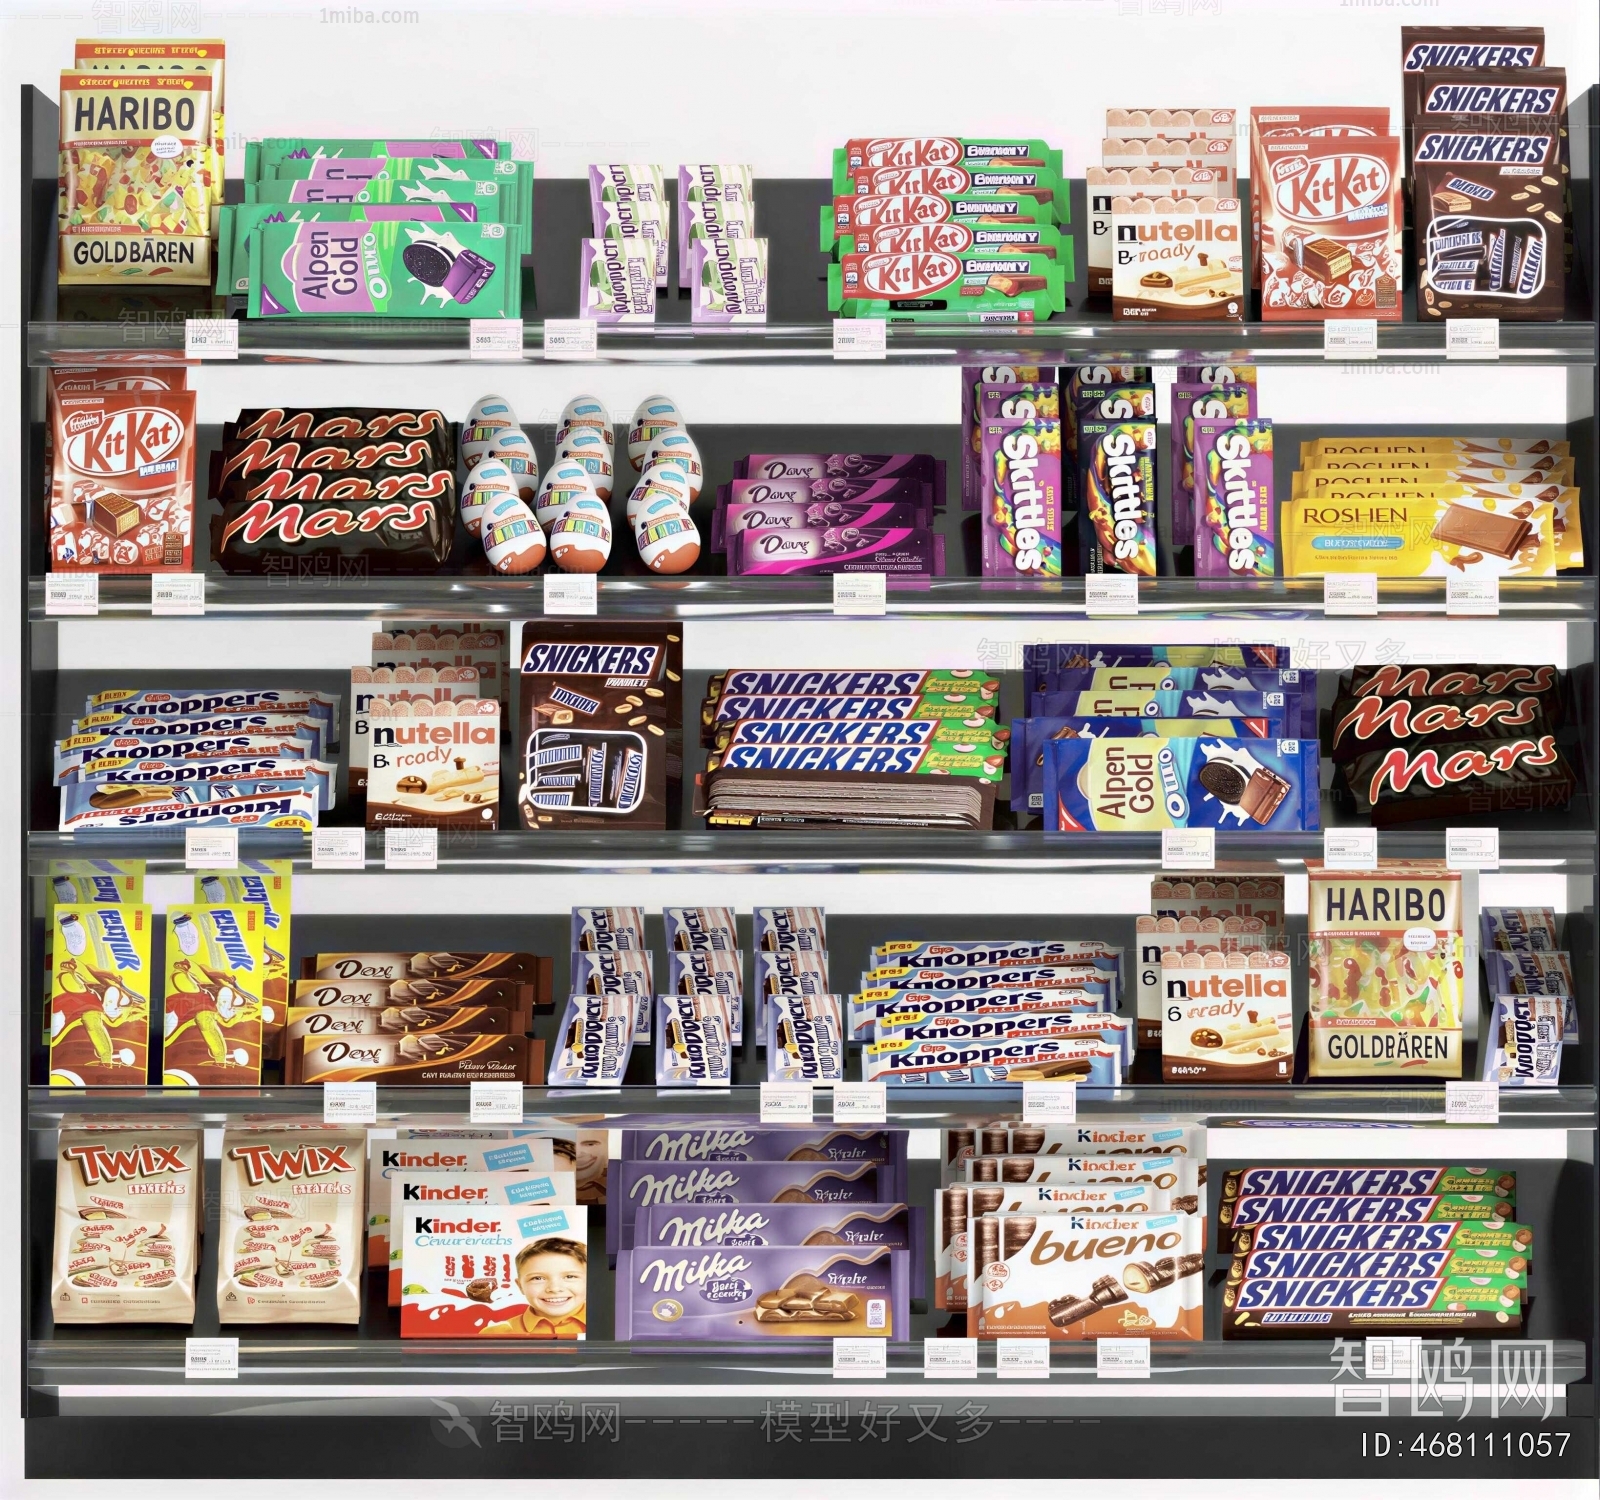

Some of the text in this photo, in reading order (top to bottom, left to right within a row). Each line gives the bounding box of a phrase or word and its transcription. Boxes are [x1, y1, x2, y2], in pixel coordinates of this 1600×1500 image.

[1406, 44, 1535, 67] SNICKERS
[74, 96, 195, 132] HARIBO
[1427, 86, 1557, 114] SNICKERS
[1419, 135, 1548, 163] SNICKERS
[1291, 157, 1381, 217] KitKat
[1117, 219, 1238, 242] nutella
[301, 231, 329, 300] Alpen
[330, 237, 359, 296] Gold
[236, 408, 444, 439] Mars
[83, 412, 173, 472] KitKat
[219, 438, 432, 484] Mars
[245, 468, 454, 501] Mars
[221, 500, 435, 551] Mars
[1303, 507, 1407, 524] ROSHEN
[524, 644, 655, 675] SNICKERS
[726, 672, 920, 694] SNICKERS
[1353, 665, 1555, 696] Mars
[718, 697, 913, 719] SNICKERS
[1333, 695, 1539, 749] Mars
[374, 722, 496, 745] nutella
[735, 721, 931, 744] SNICKERS
[725, 746, 921, 773] SNICKERS
[1369, 735, 1558, 805] Mars
[1097, 747, 1125, 820] Alpen
[1127, 754, 1155, 814] Gold
[1326, 887, 1446, 922] HARIBO
[899, 941, 1065, 968] Knoppers
[1142, 970, 1157, 986] 6
[876, 990, 1044, 1017] Knoppers
[1167, 1006, 1182, 1022] 6
[904, 1015, 1073, 1041] Knoppers
[890, 1041, 1060, 1068] Knoppers
[382, 1150, 466, 1167] Kinder
[403, 1183, 488, 1201] Kinder
[630, 1167, 740, 1207] Milka
[1241, 1169, 1437, 1195] SNICKERS
[1236, 1196, 1432, 1224] SNICKERS
[415, 1216, 501, 1234] Kinder
[659, 1208, 769, 1247] Milka
[1256, 1224, 1453, 1250] SNICKERS
[1030, 1230, 1182, 1266] bueno
[639, 1251, 752, 1293] Milka
[1248, 1251, 1445, 1277] SNICKERS
[1238, 1278, 1438, 1308] SNICKERS
